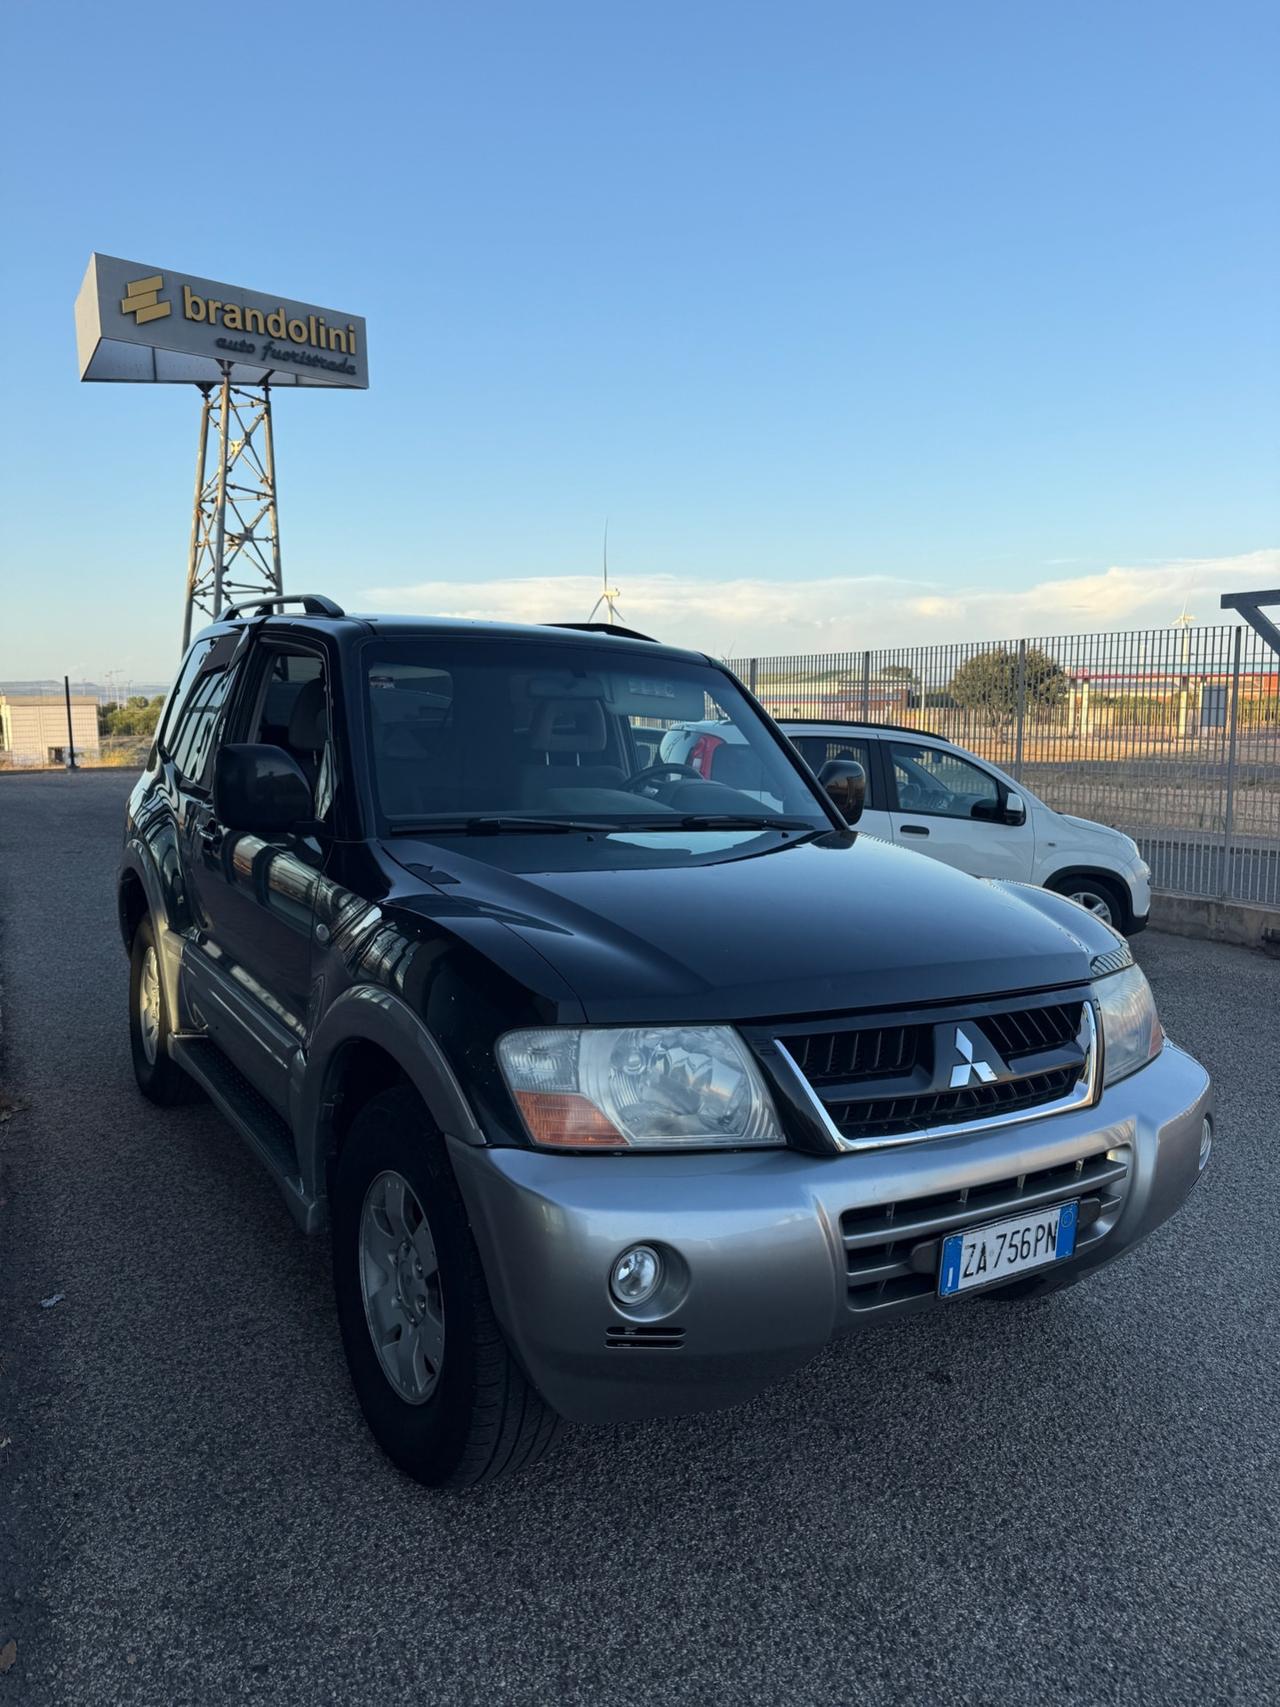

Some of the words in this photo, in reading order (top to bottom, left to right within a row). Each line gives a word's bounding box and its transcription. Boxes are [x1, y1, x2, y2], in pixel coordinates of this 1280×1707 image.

[183, 286, 356, 355] brandolini
[215, 336, 256, 354] auto
[261, 341, 357, 375] fuoristrada
